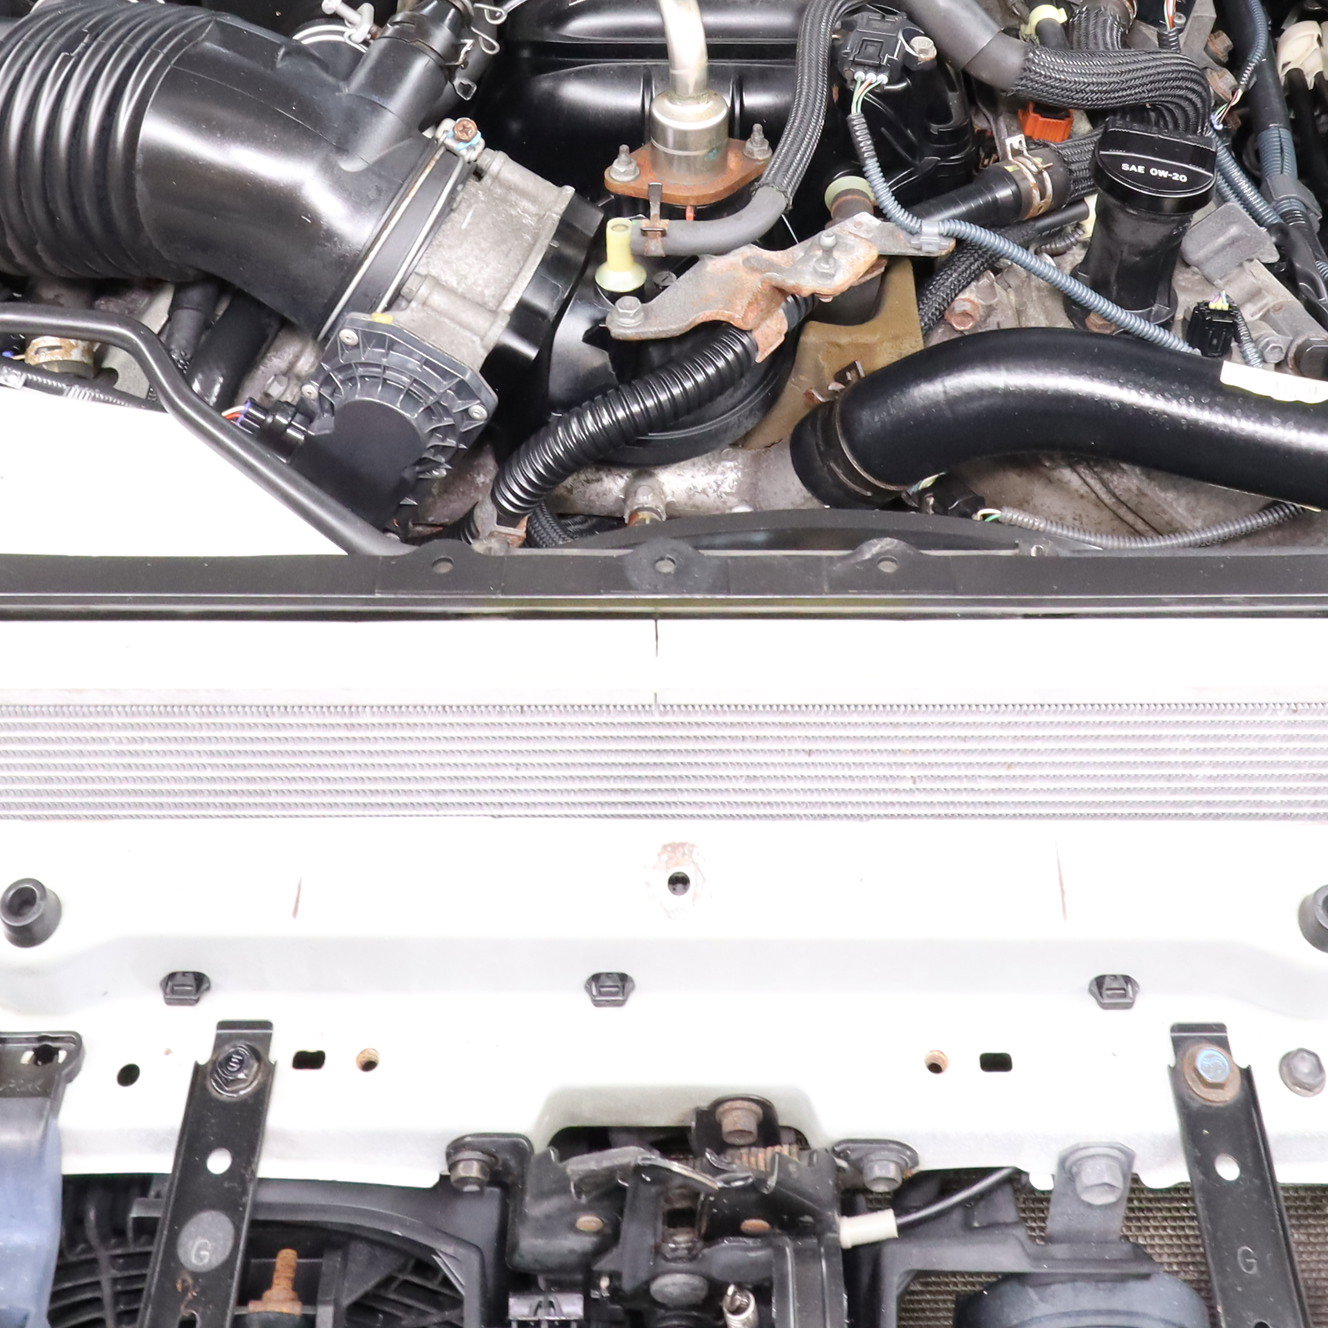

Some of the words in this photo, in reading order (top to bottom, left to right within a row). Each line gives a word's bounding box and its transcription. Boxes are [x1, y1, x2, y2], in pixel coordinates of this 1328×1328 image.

[1121, 163, 1145, 174] SAE
[1149, 167, 1188, 183] 0W-20
[190, 1238, 212, 1265] G
[1237, 1245, 1257, 1275] G
